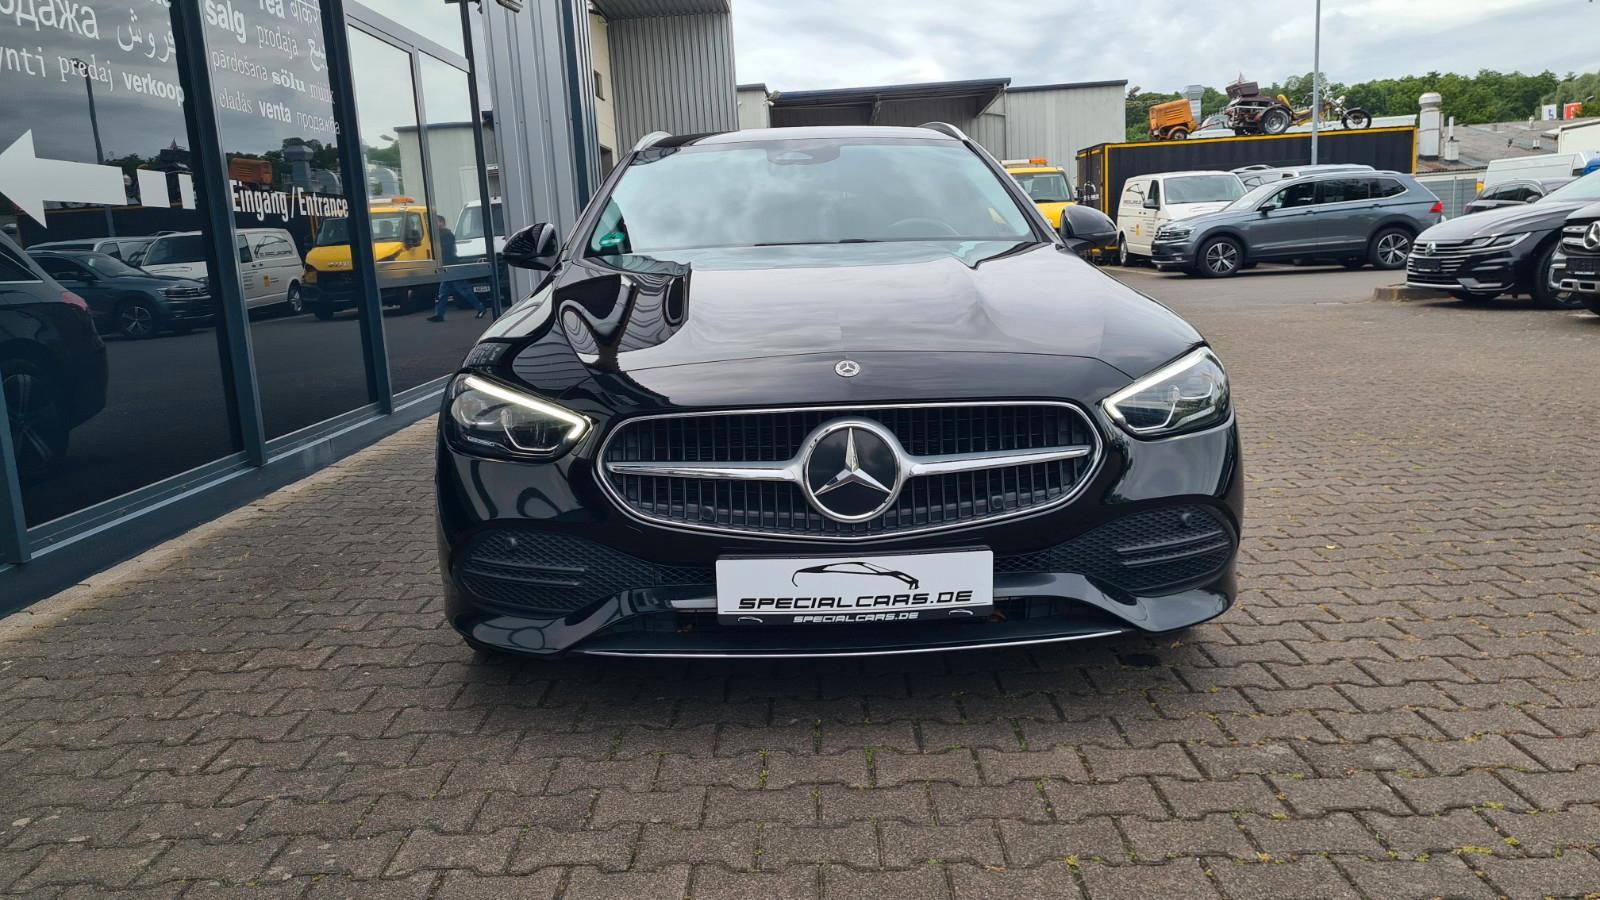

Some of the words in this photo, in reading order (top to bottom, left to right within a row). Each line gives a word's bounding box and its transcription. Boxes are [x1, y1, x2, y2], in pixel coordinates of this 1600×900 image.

[205, 0, 247, 44] salg
[256, 24, 299, 60] prodaja
[57, 54, 113, 92] predaj
[122, 71, 185, 107] verkoop
[271, 68, 306, 93] sölu
[258, 100, 292, 123] venta
[738, 590, 974, 610] SPECIALCARS.DE
[793, 612, 919, 623] SPECIALCARS.DE
